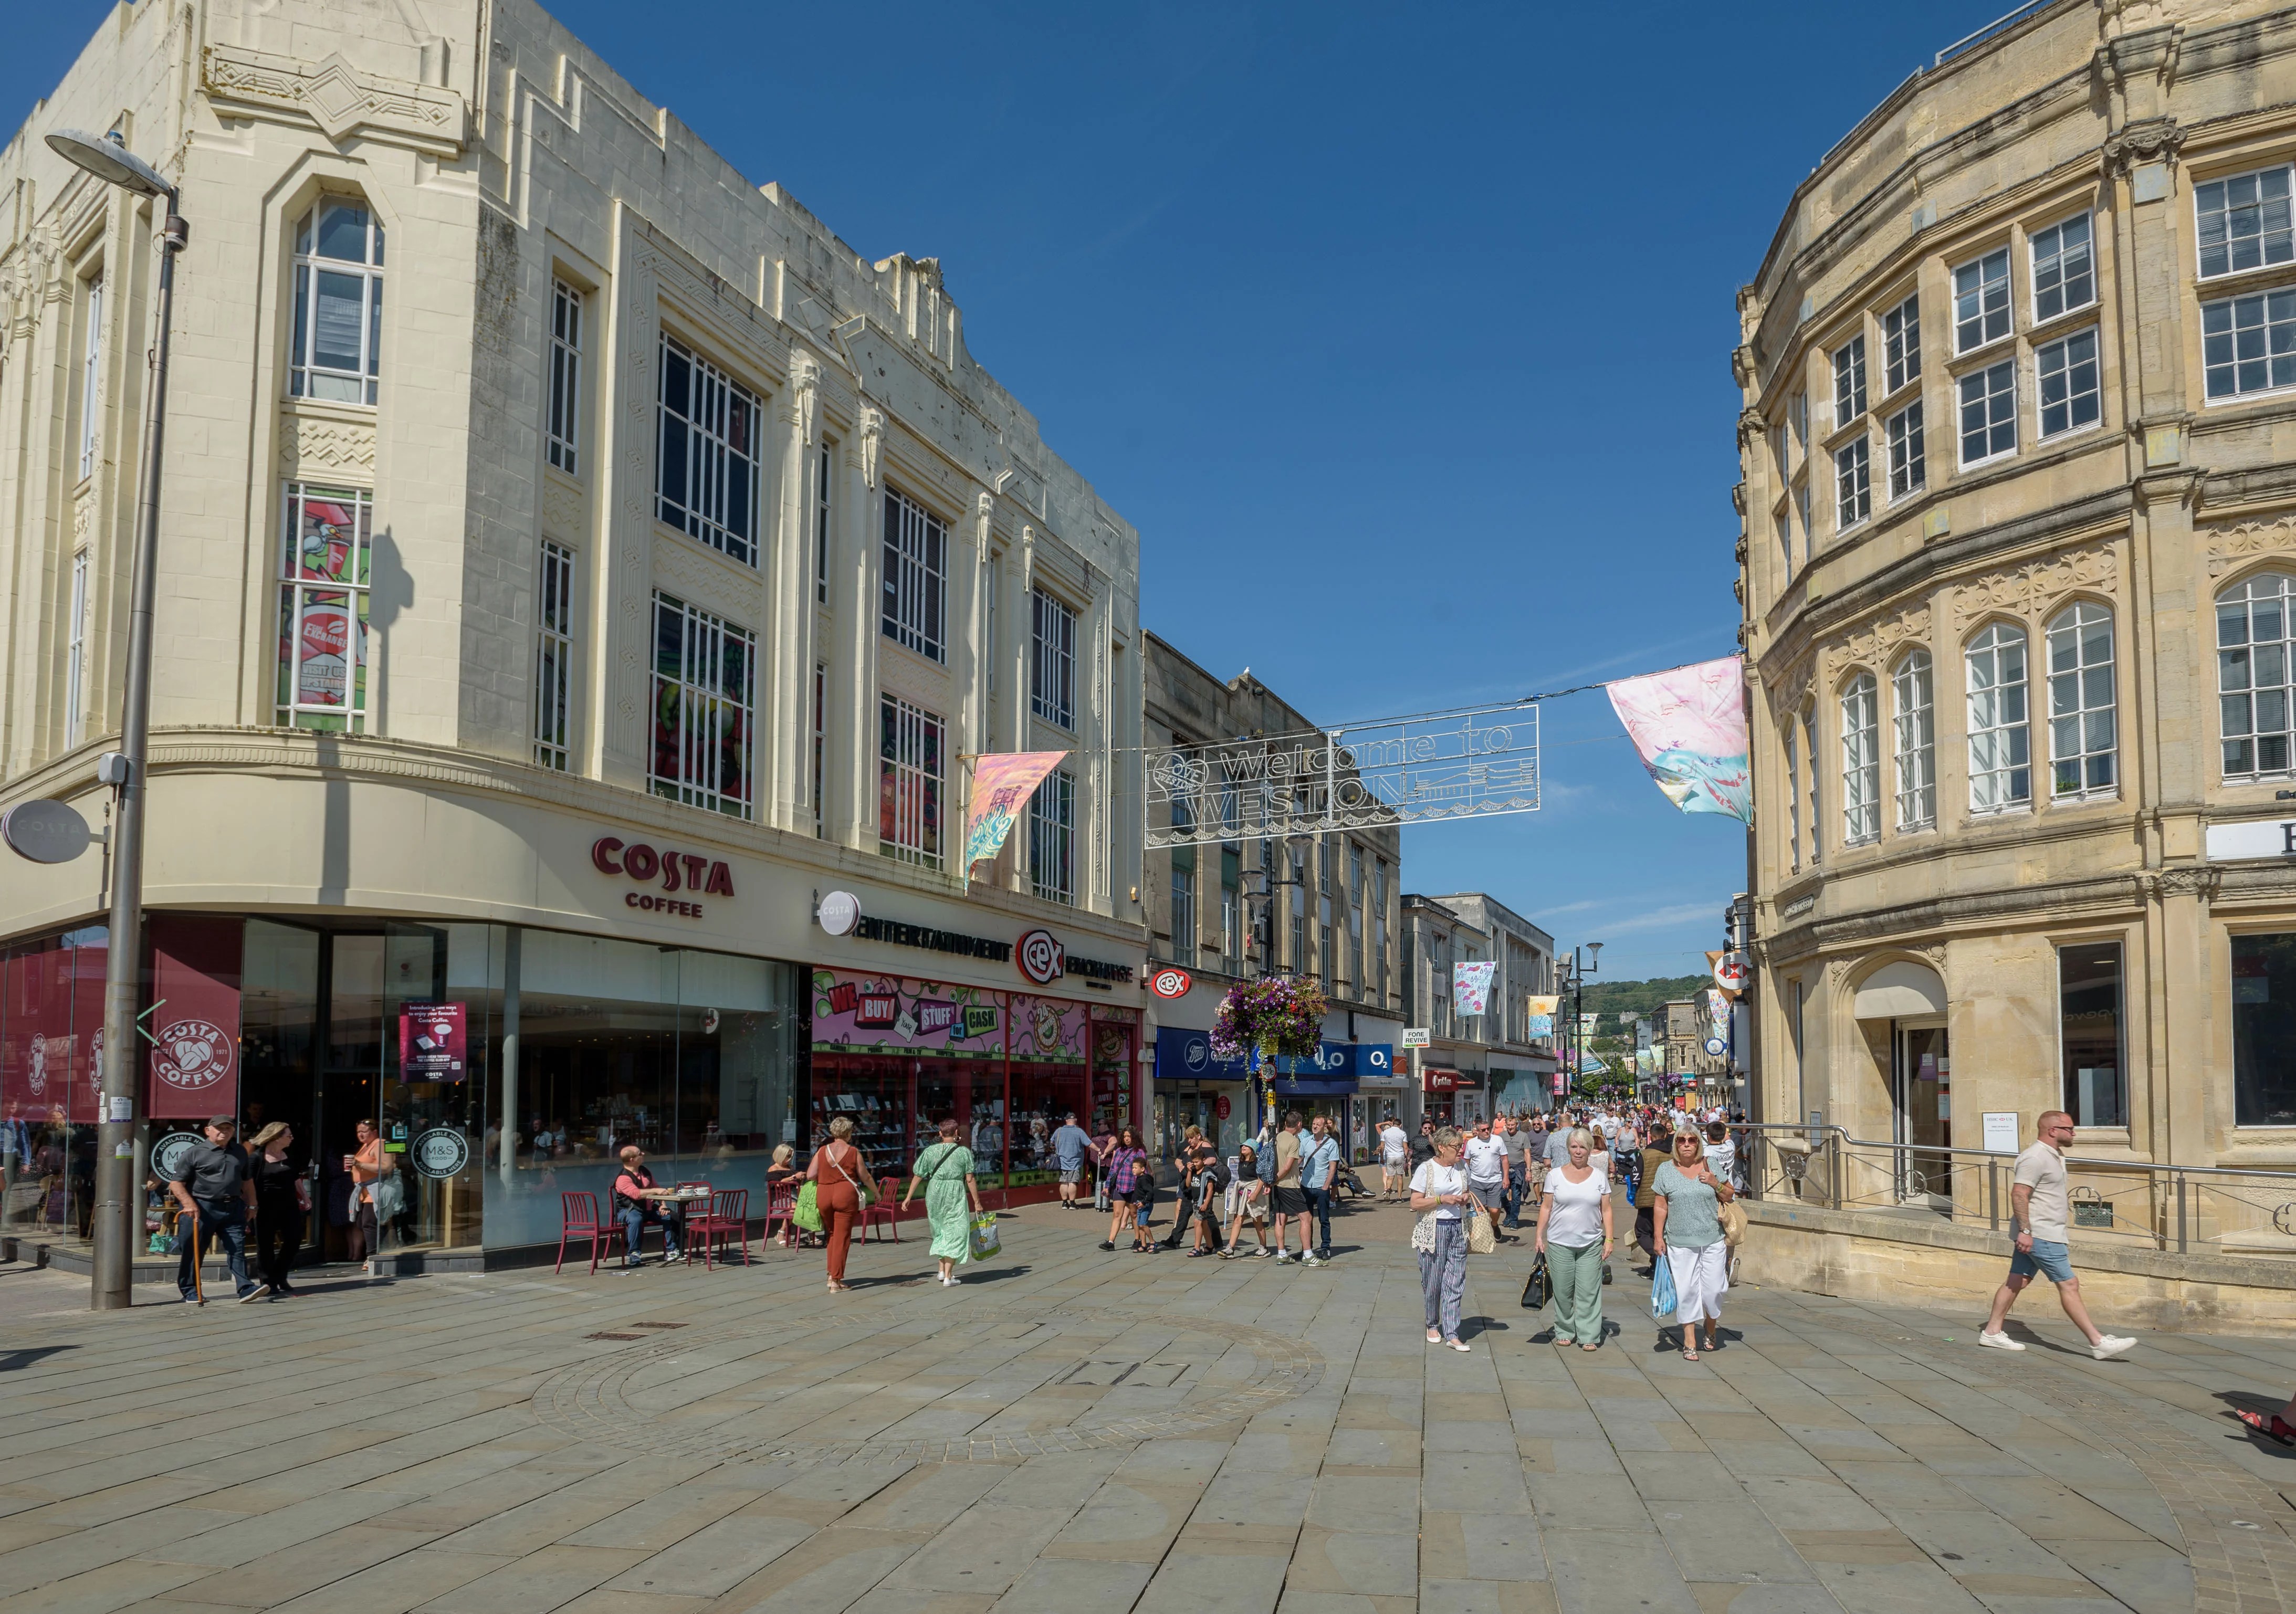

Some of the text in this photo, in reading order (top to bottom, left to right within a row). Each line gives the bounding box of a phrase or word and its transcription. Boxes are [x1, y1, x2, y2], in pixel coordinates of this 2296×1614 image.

[302, 664, 346, 677] VISIT US
[300, 676, 345, 690] UPSTAIRS
[1220, 722, 1512, 782] Welcome to
[1186, 773, 1404, 825] WESTON
[17, 819, 80, 835] COSTA
[592, 837, 735, 897] COSTA
[625, 893, 703, 918] COFFEE
[823, 906, 850, 915] COSTA
[852, 915, 1013, 962] ENTERTAINMENT
[1066, 956, 1133, 983] EXCHANGE
[828, 982, 995, 1035] WE BUY YOUR STUFF for CASH
[1037, 1003, 1049, 1022] 24
[164, 1024, 218, 1043] COSTA
[1037, 1016, 1055, 1036] MONTHS
[32, 1036, 47, 1054] COSTA
[92, 1031, 103, 1050] COS
[1188, 1045, 1205, 1063] Boots
[1370, 1051, 1388, 1069] O2
[91, 1070, 101, 1091] COF
[159, 1062, 224, 1085] COFFEE
[159, 1136, 193, 1151] AVAILABLE
[418, 1131, 463, 1147] AVAILABLE HERE
[426, 1146, 454, 1156] M&S
[158, 1167, 173, 1180] AVAIL
[417, 1160, 462, 1175] AVAILABLE HERE
